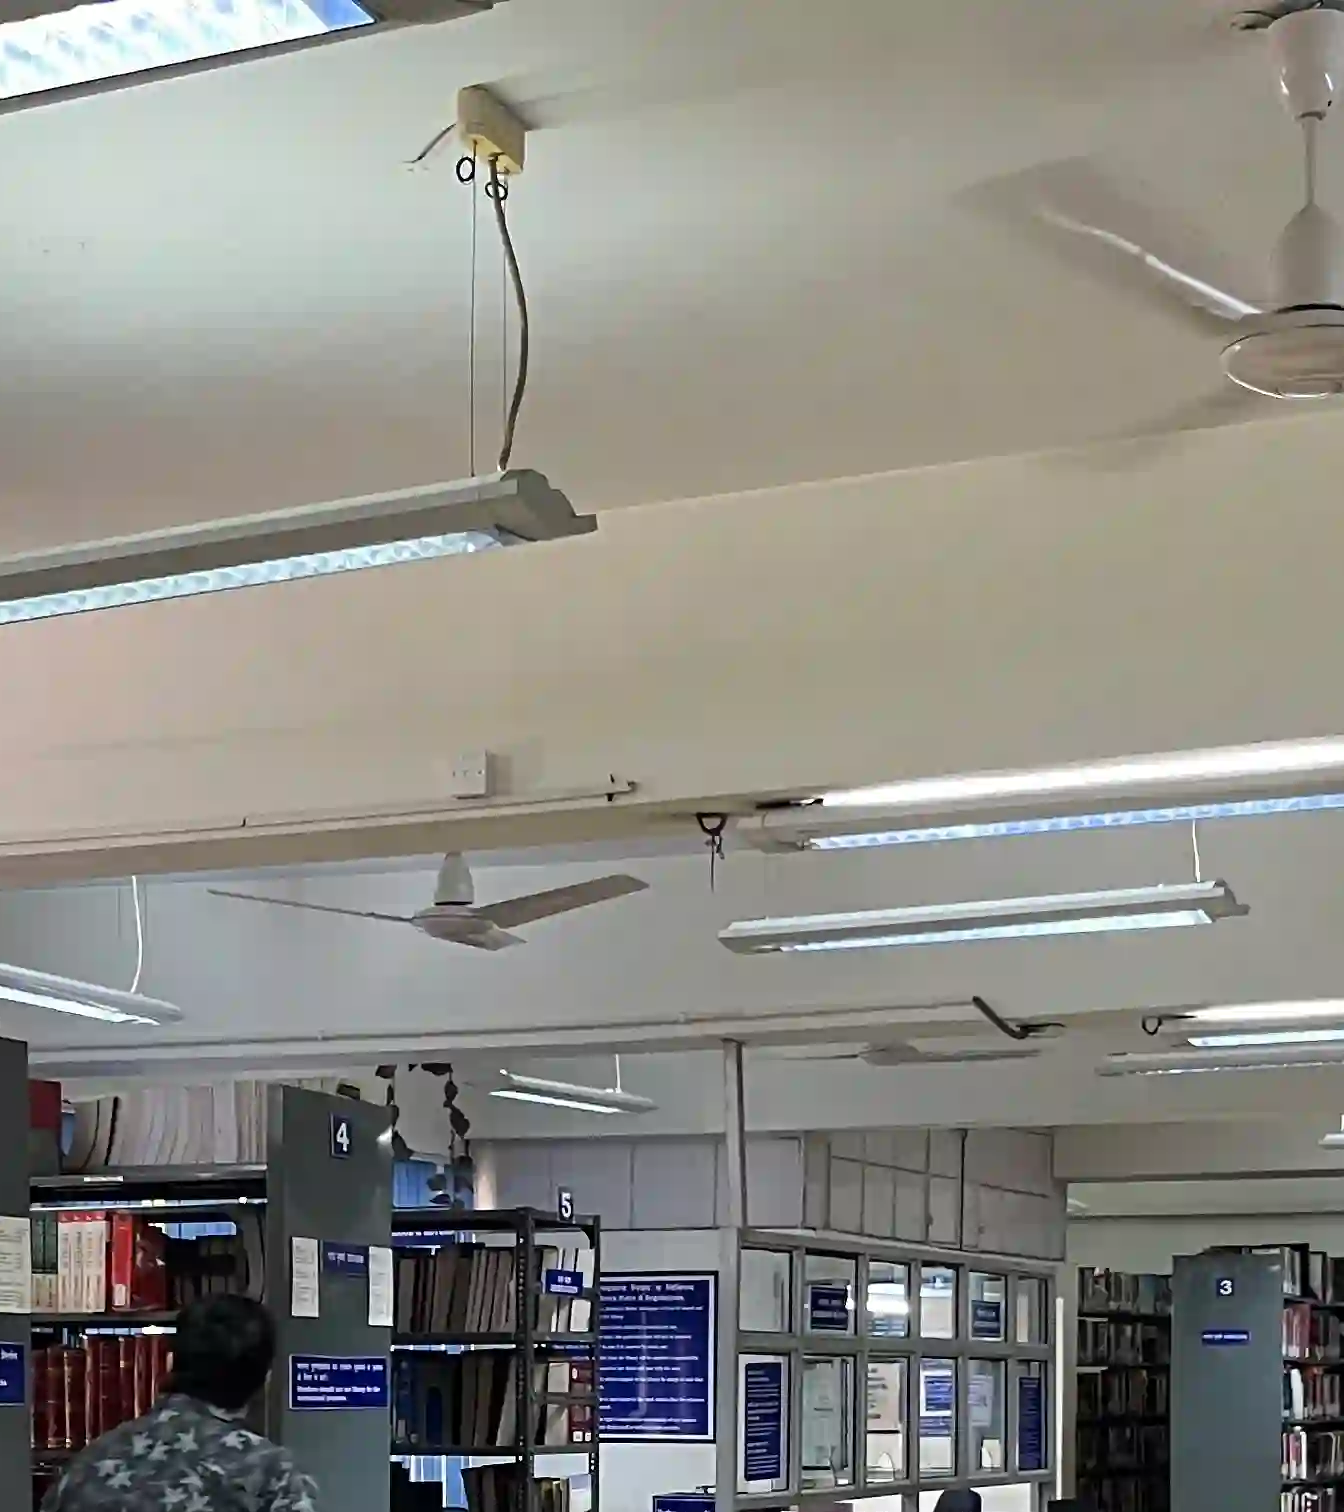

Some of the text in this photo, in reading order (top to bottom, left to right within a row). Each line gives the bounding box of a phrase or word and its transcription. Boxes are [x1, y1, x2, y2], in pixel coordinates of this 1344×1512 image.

[336, 1122, 350, 1152] 4
[561, 1192, 572, 1218] 5
[1219, 1280, 1232, 1295] 3
